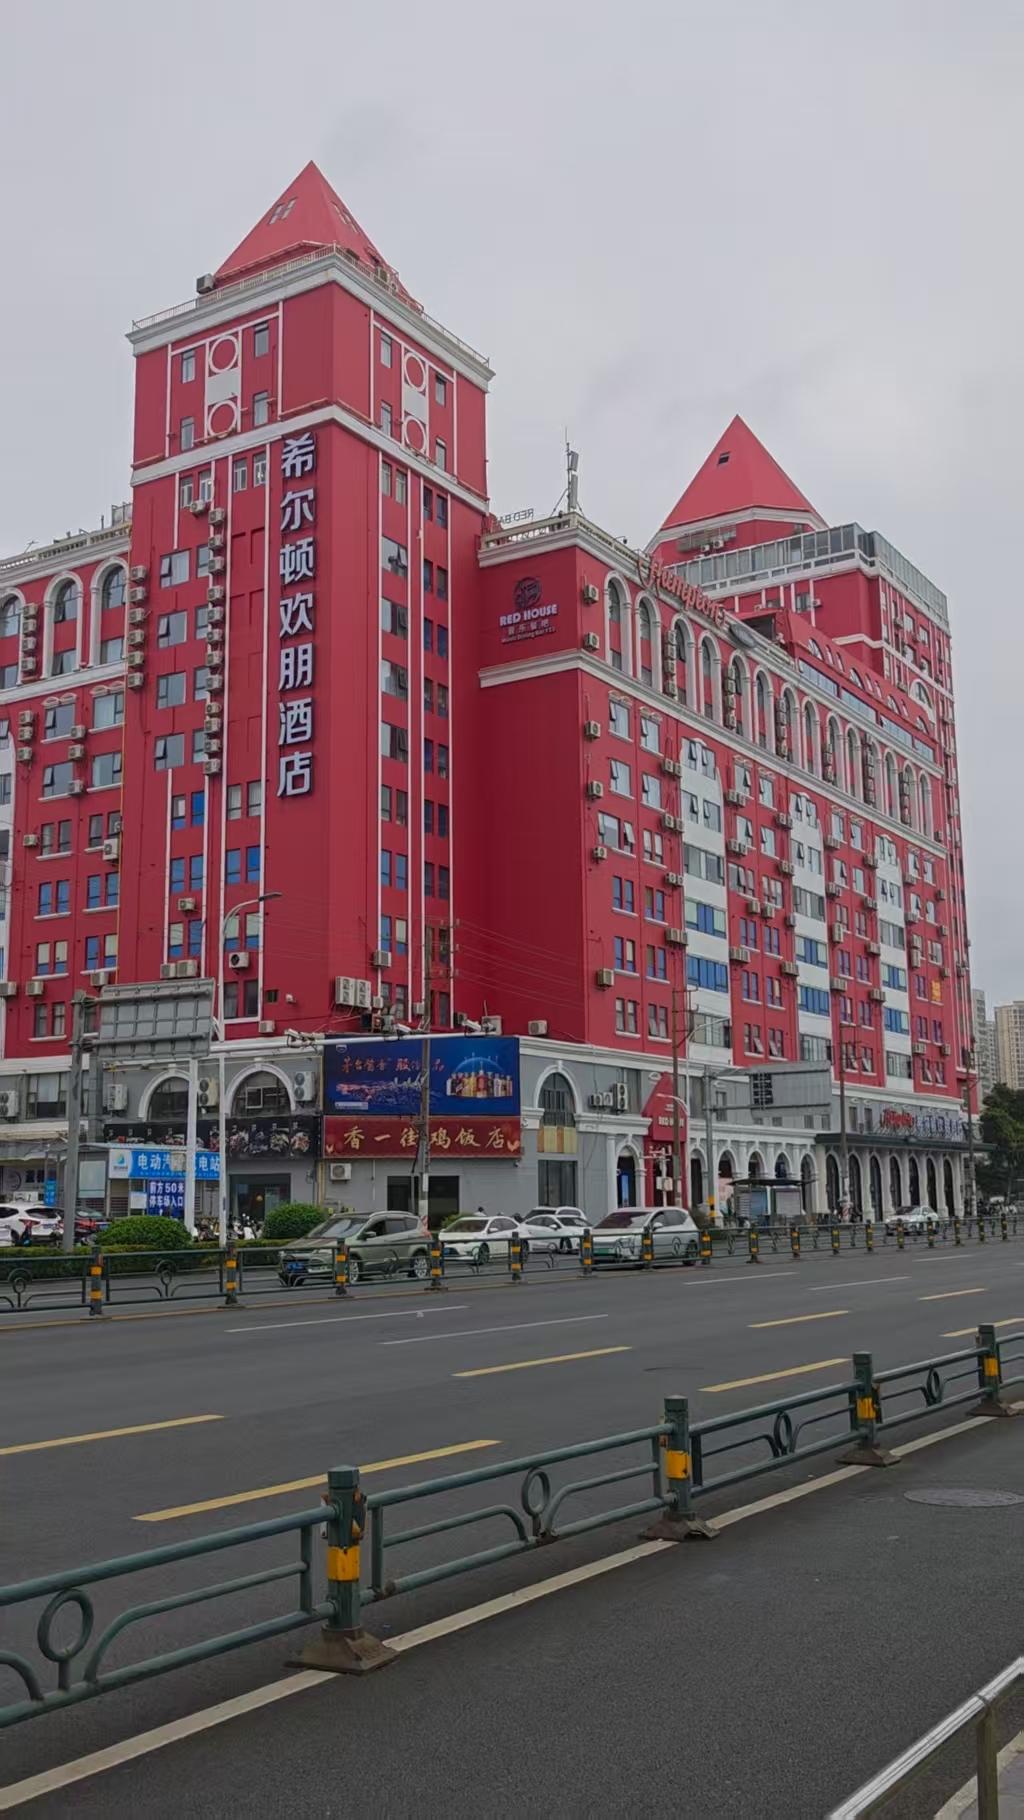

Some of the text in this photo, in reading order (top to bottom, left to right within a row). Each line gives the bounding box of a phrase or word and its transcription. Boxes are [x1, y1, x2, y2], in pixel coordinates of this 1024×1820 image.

[277, 431, 315, 797] 希尔顿欢朋酒店
[500, 604, 557, 626] RED HOUSE
[149, 1195, 184, 1208] 停车场入口
